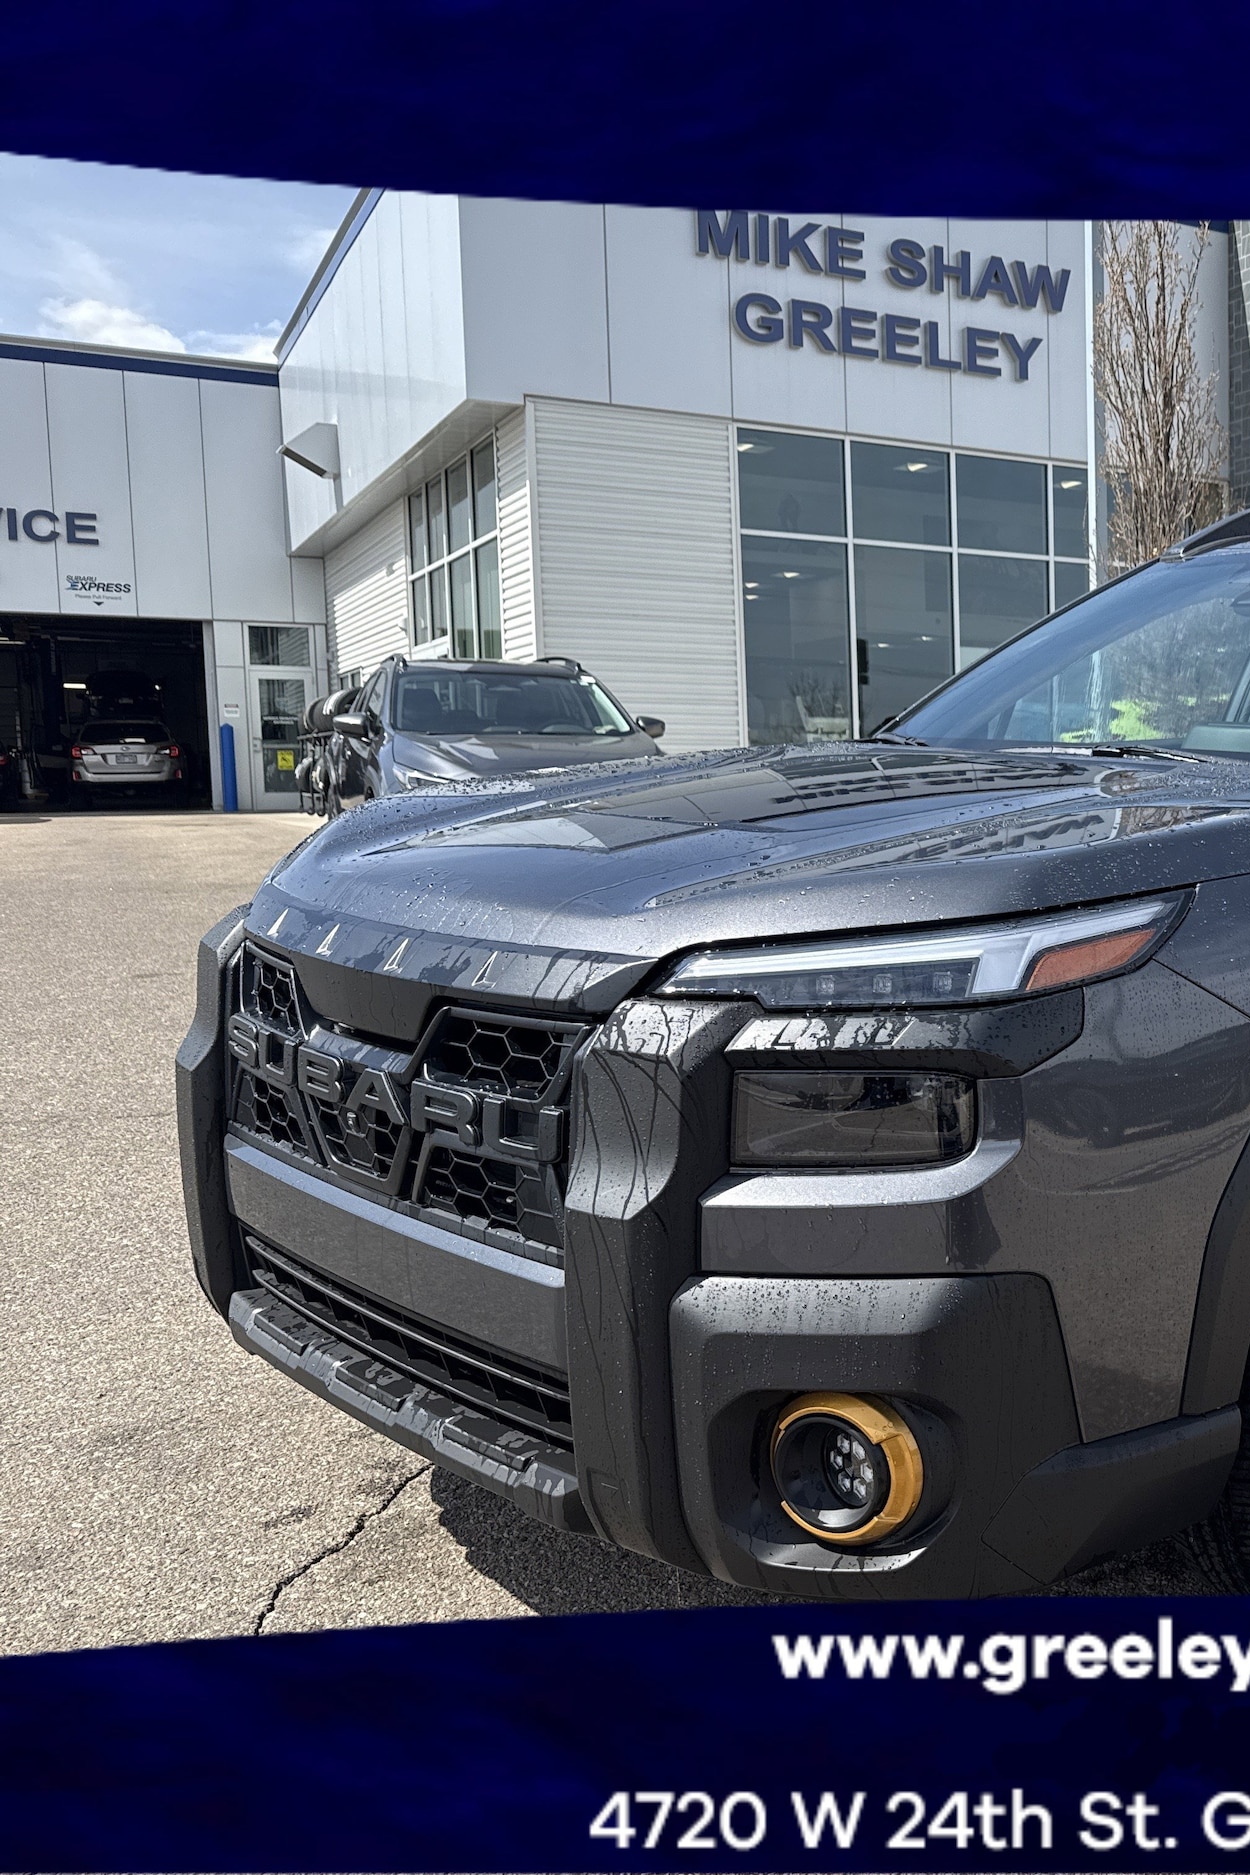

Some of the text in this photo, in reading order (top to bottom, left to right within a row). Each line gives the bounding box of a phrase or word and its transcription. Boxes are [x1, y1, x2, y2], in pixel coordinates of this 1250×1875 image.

[696, 209, 1071, 313] MIKE SHAW
[734, 292, 1043, 382] GREELEY
[0, 507, 99, 546] ICE
[66, 575, 97, 583] SUBARU
[67, 581, 131, 594] EXPRESS
[228, 1014, 566, 1164] SUBARU
